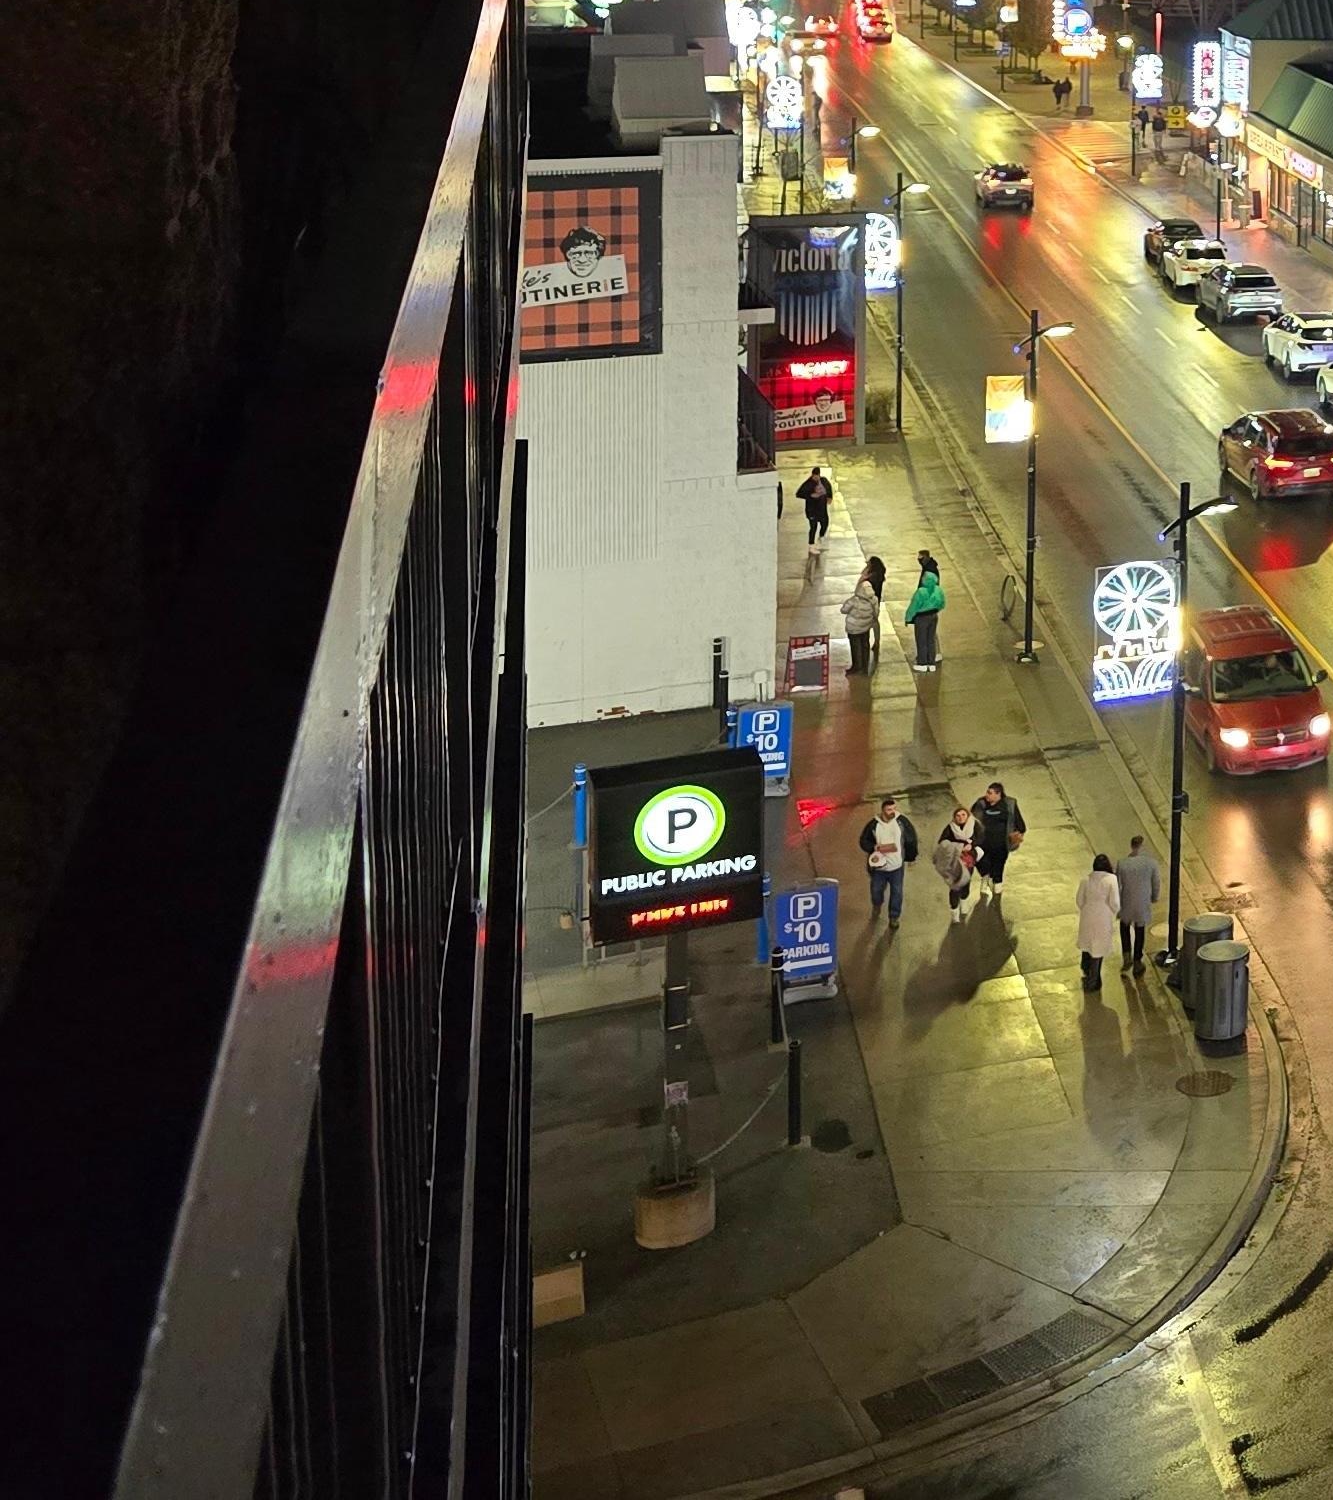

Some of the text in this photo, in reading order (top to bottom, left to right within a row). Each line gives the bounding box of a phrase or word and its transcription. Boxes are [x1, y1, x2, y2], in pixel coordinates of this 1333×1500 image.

[601, 854, 757, 895] PUBLIC PARKING
[784, 921, 821, 943] $10
[783, 943, 830, 959] PARKING
